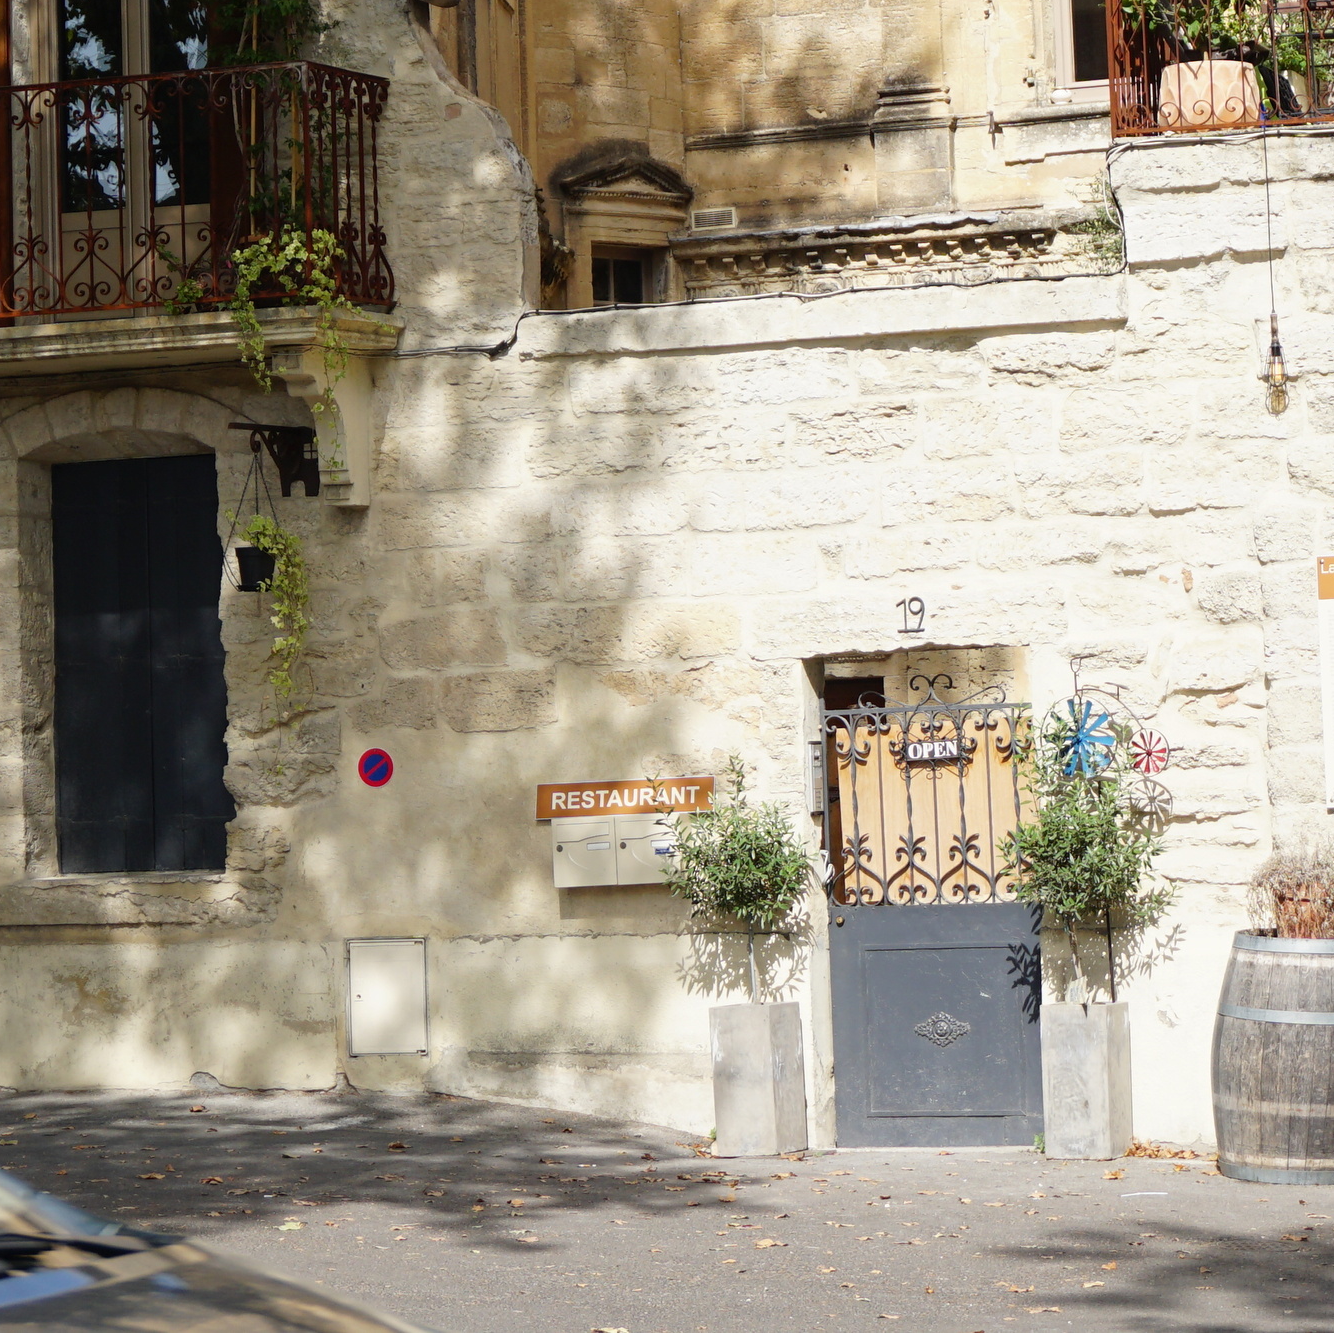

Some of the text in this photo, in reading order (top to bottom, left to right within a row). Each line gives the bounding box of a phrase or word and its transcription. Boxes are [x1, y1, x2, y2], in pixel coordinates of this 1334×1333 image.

[895, 596, 926, 633] 19
[908, 740, 958, 760] OPEN
[551, 785, 700, 810] RESTAURANT
